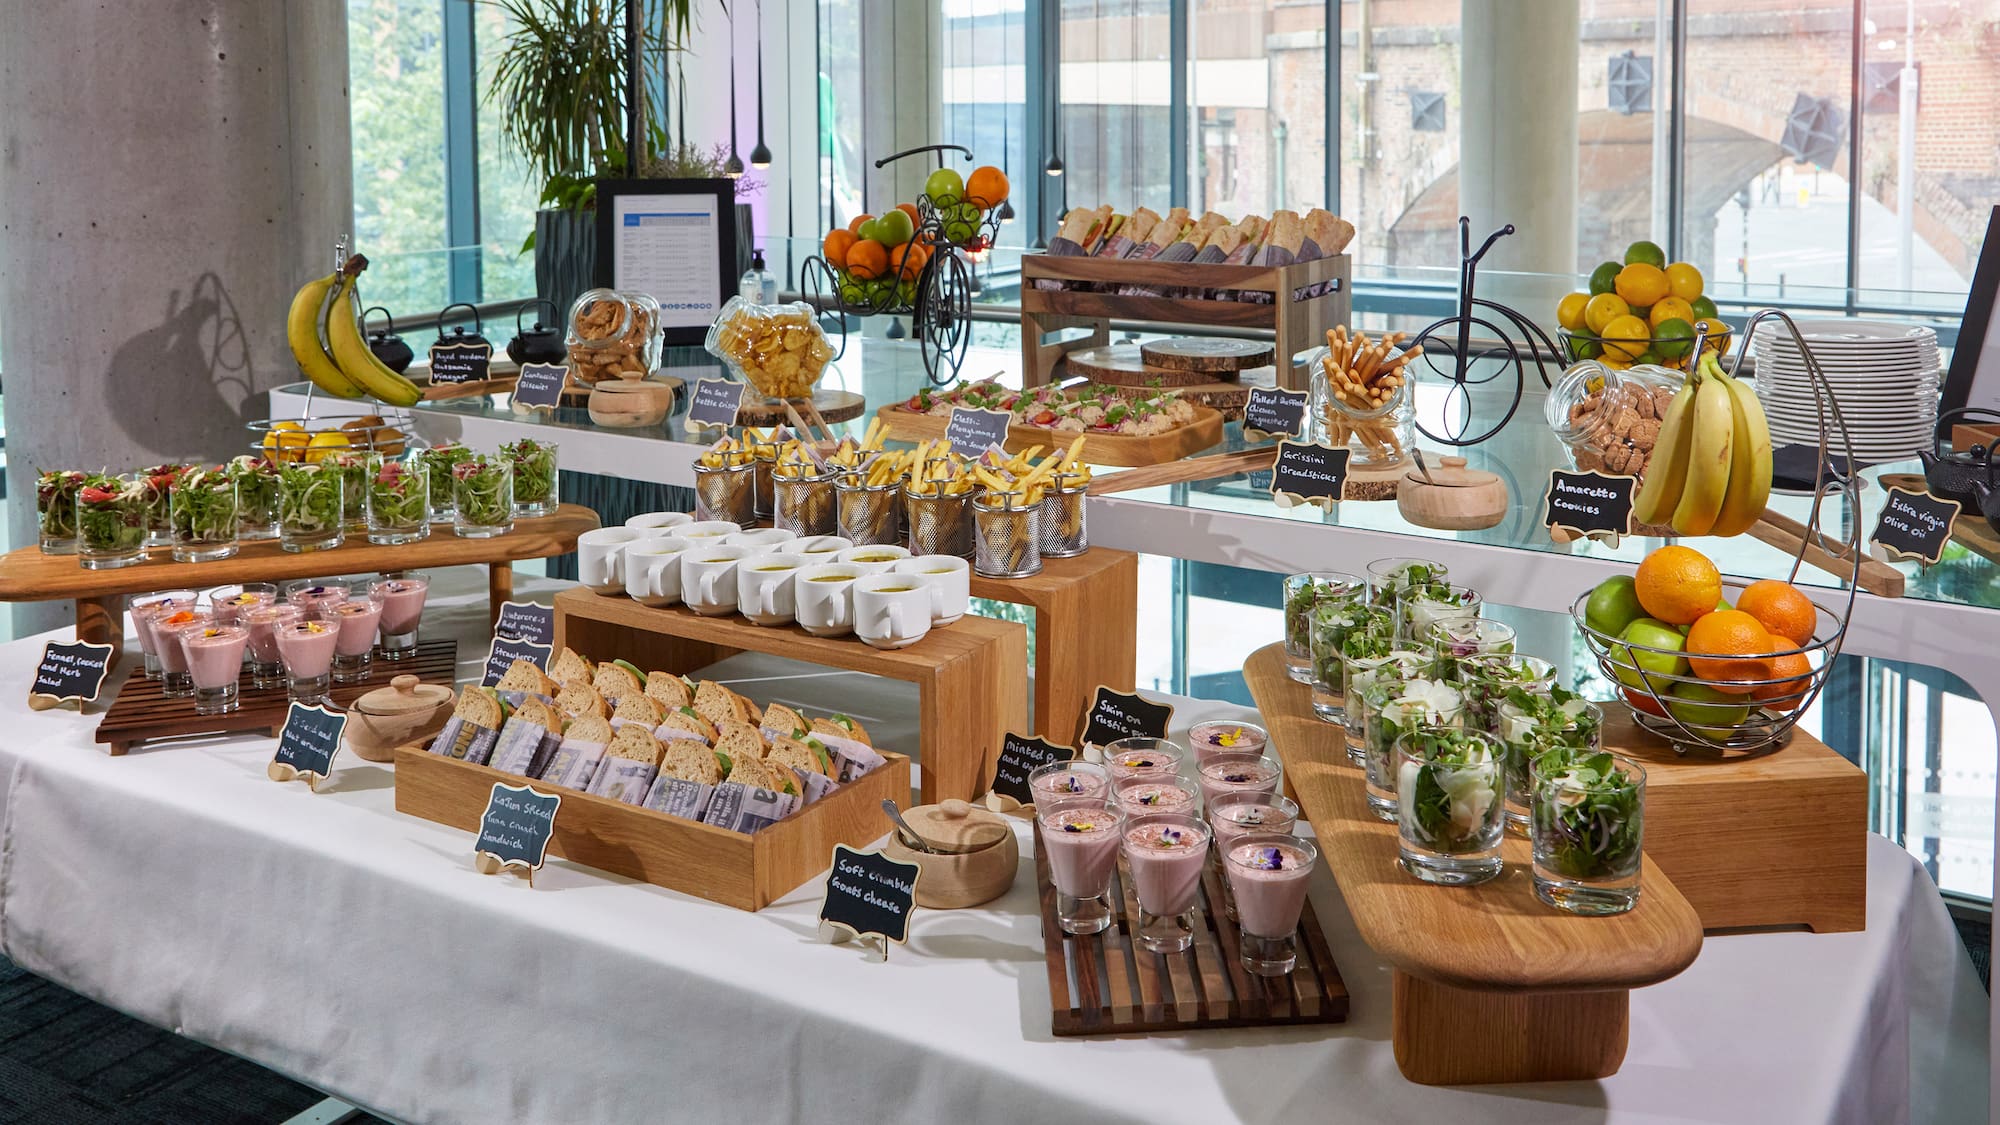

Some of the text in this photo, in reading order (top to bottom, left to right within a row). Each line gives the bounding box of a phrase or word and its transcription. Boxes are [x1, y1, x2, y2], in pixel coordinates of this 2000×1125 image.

[1252, 392, 1277, 404] Pulled
[1283, 450, 1325, 465] Grissini
[1556, 479, 1617, 500] Amaretto
[1554, 498, 1600, 515] Cookies
[1891, 497, 1917, 518] Extra
[1884, 516, 1909, 532] Olive
[41, 663, 81, 678] and Herb
[38, 674, 62, 687] Salad
[1100, 700, 1142, 725] Skin on
[280, 746, 294, 759] Mix
[1002, 754, 1020, 766] and
[487, 810, 506, 826] Tuna
[482, 830, 523, 849] Sandwich
[838, 859, 865, 878] Soft
[832, 876, 862, 898] Goats
